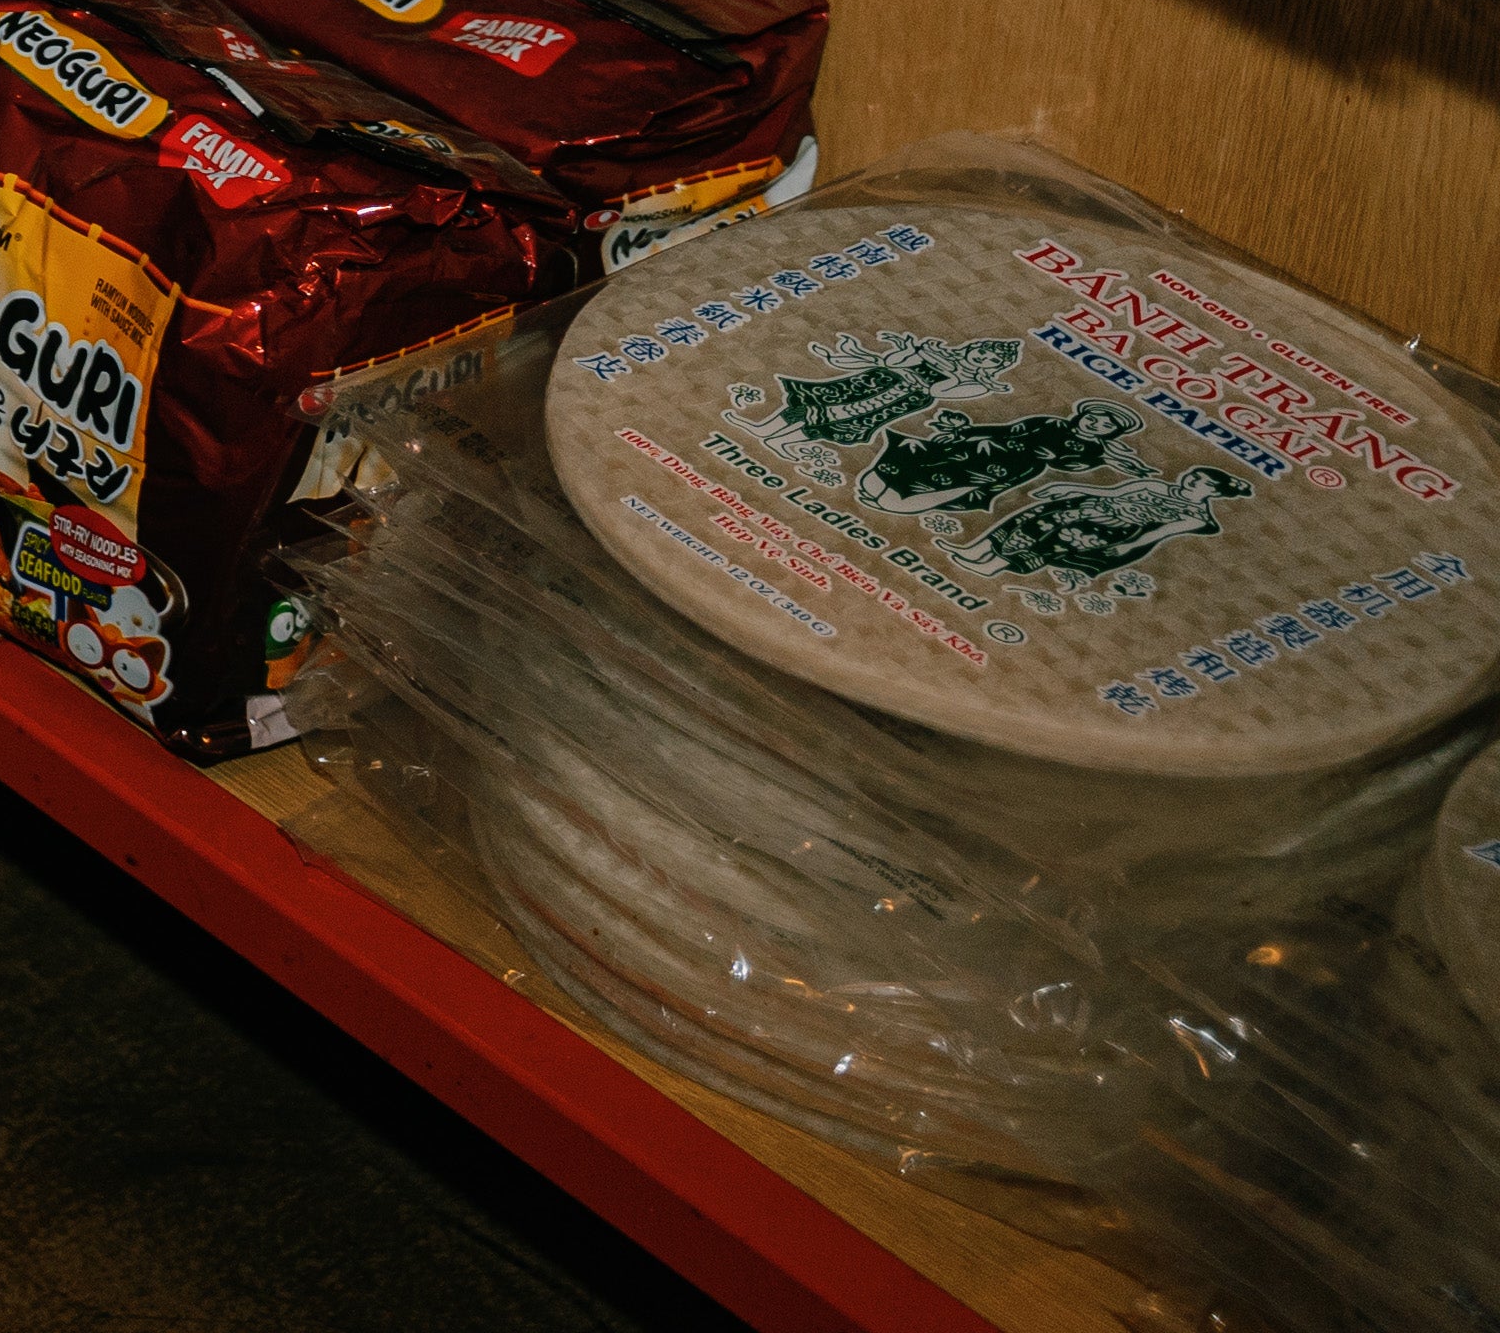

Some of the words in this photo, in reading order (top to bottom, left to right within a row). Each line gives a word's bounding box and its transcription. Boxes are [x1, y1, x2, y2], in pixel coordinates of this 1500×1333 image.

[453, 32, 528, 63] PACK
[459, 17, 568, 49] FAMILY
[1017, 239, 1220, 359] BÁNH
[1217, 353, 1460, 504] TRÁNG
[1060, 307, 1132, 359] BA
[1142, 353, 1220, 403] CÔ
[1153, 270, 1251, 333] NON-GMO
[1269, 340, 1354, 393] GLUTEN
[1353, 389, 1414, 427] FREE
[1033, 324, 1145, 394] RICE
[1142, 390, 1289, 480] PAPER
[10, 405, 131, 503] 너구리
[17, 547, 83, 597] SEAFOOD
[53, 512, 90, 549] STIR-FRY
[89, 529, 139, 566] NOODLES
[702, 432, 786, 491] Three
[784, 485, 890, 553] Ladies
[884, 546, 992, 615] Brand
